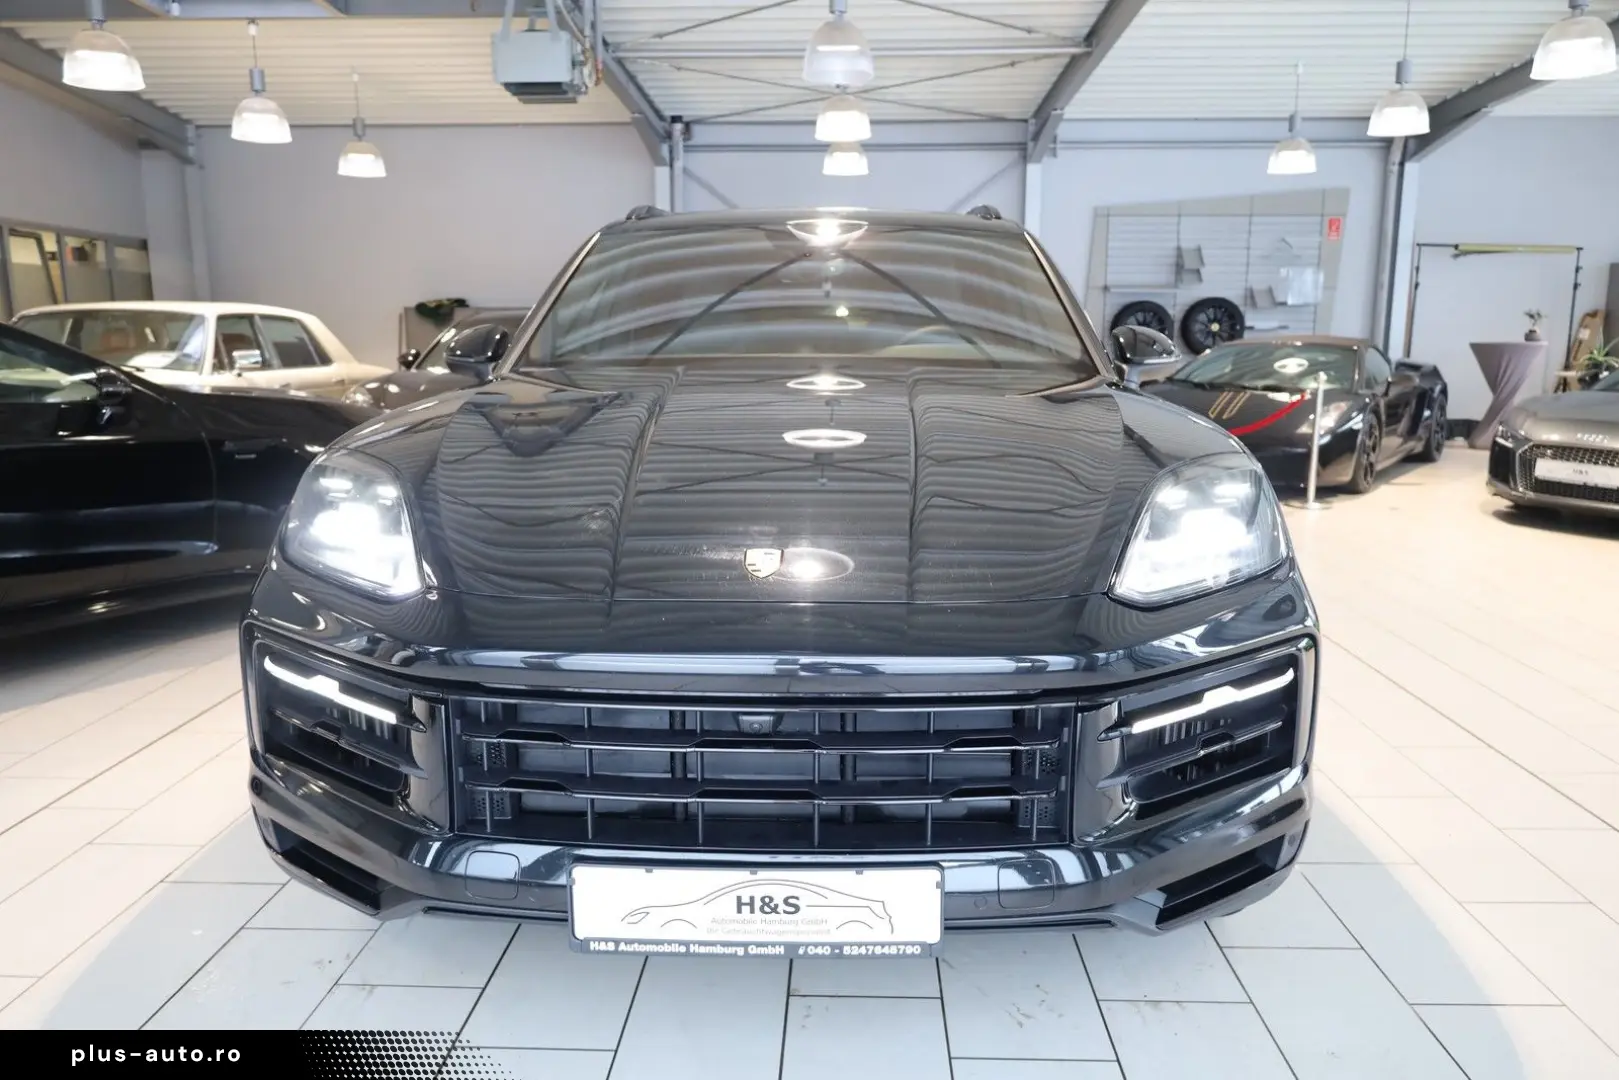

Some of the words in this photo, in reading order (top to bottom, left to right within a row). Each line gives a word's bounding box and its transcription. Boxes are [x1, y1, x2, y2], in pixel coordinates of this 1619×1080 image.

[736, 895, 801, 915] H&S
[711, 917, 758, 925] Automobile
[760, 917, 799, 926] Hamburg
[801, 917, 828, 925] GmbH
[589, 941, 616, 951] H&S
[618, 941, 687, 953] Automobile
[689, 943, 745, 956] Hamburg
[747, 944, 785, 955] GmbH
[807, 945, 832, 955] 040
